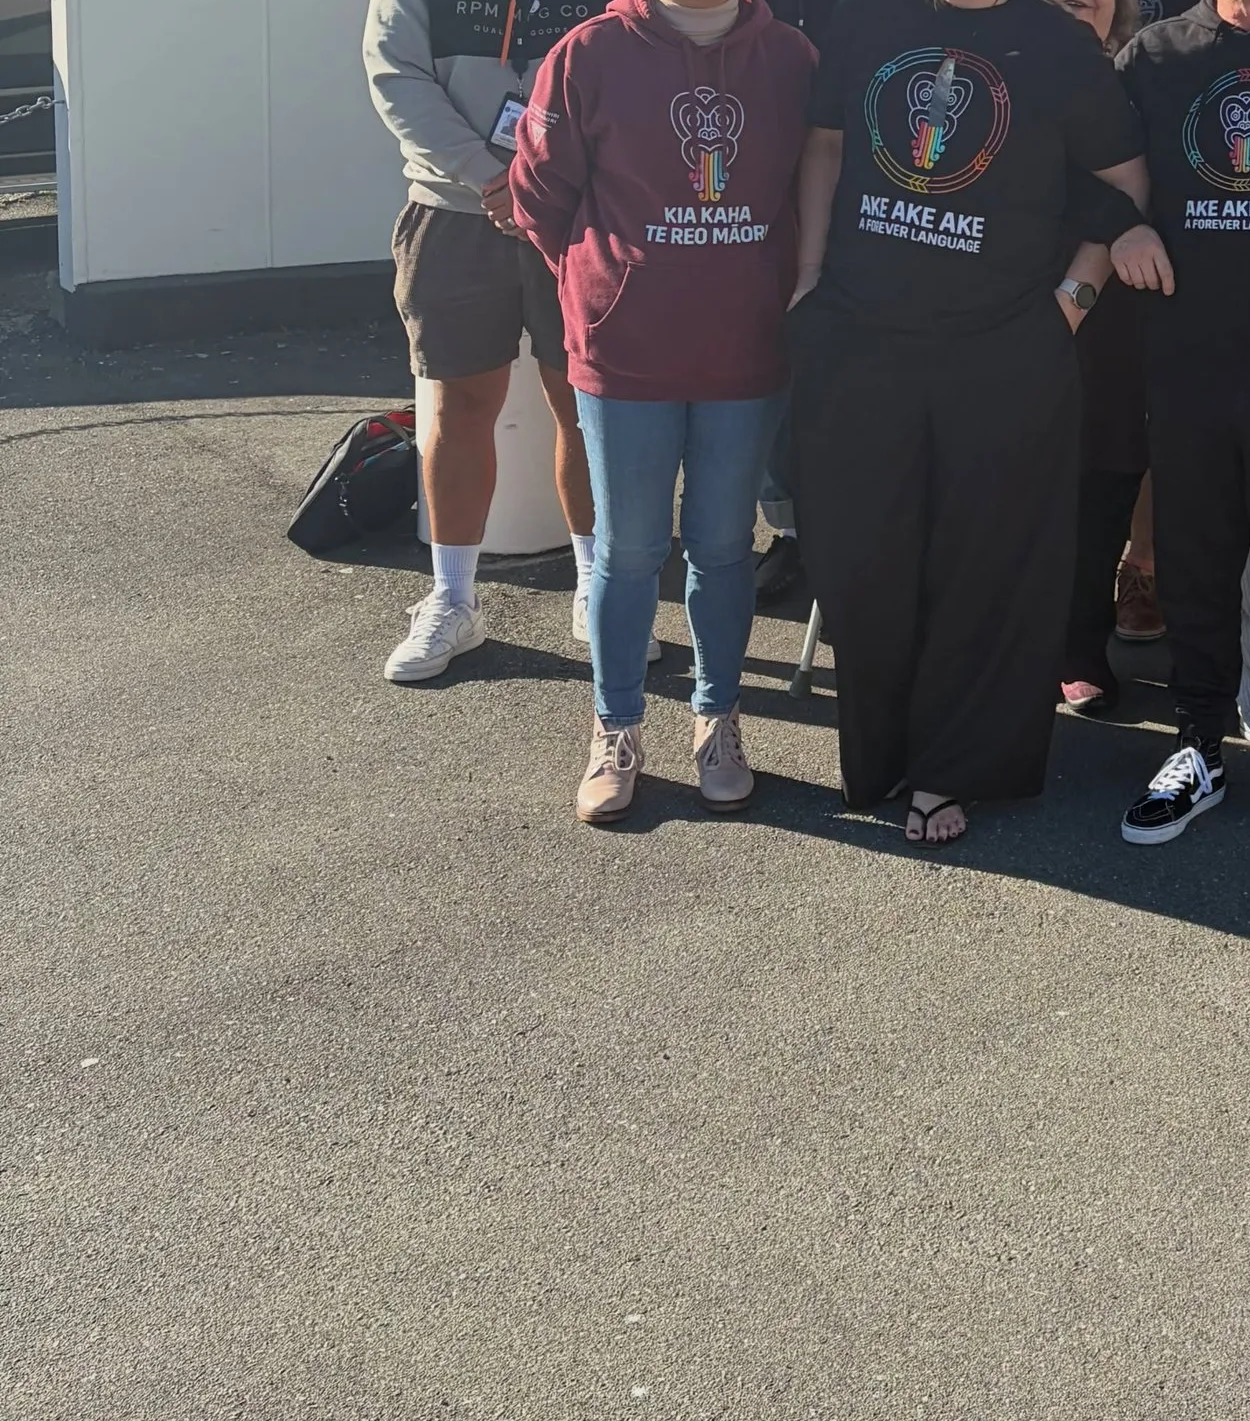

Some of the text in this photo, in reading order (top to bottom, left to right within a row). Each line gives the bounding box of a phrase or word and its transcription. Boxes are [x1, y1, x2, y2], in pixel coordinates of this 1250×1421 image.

[456, 0, 499, 17] RPM
[560, 4, 588, 17] CO
[664, 205, 752, 224] KIA KAHA
[860, 194, 985, 238] AKE AKE AKE
[1185, 199, 1219, 217] AKE
[1184, 218, 1191, 229] A
[1192, 218, 1240, 230] FOREVER
[645, 225, 668, 243] TE
[670, 227, 708, 245] REO
[858, 217, 981, 254] A FOREVER LANGUAGE
